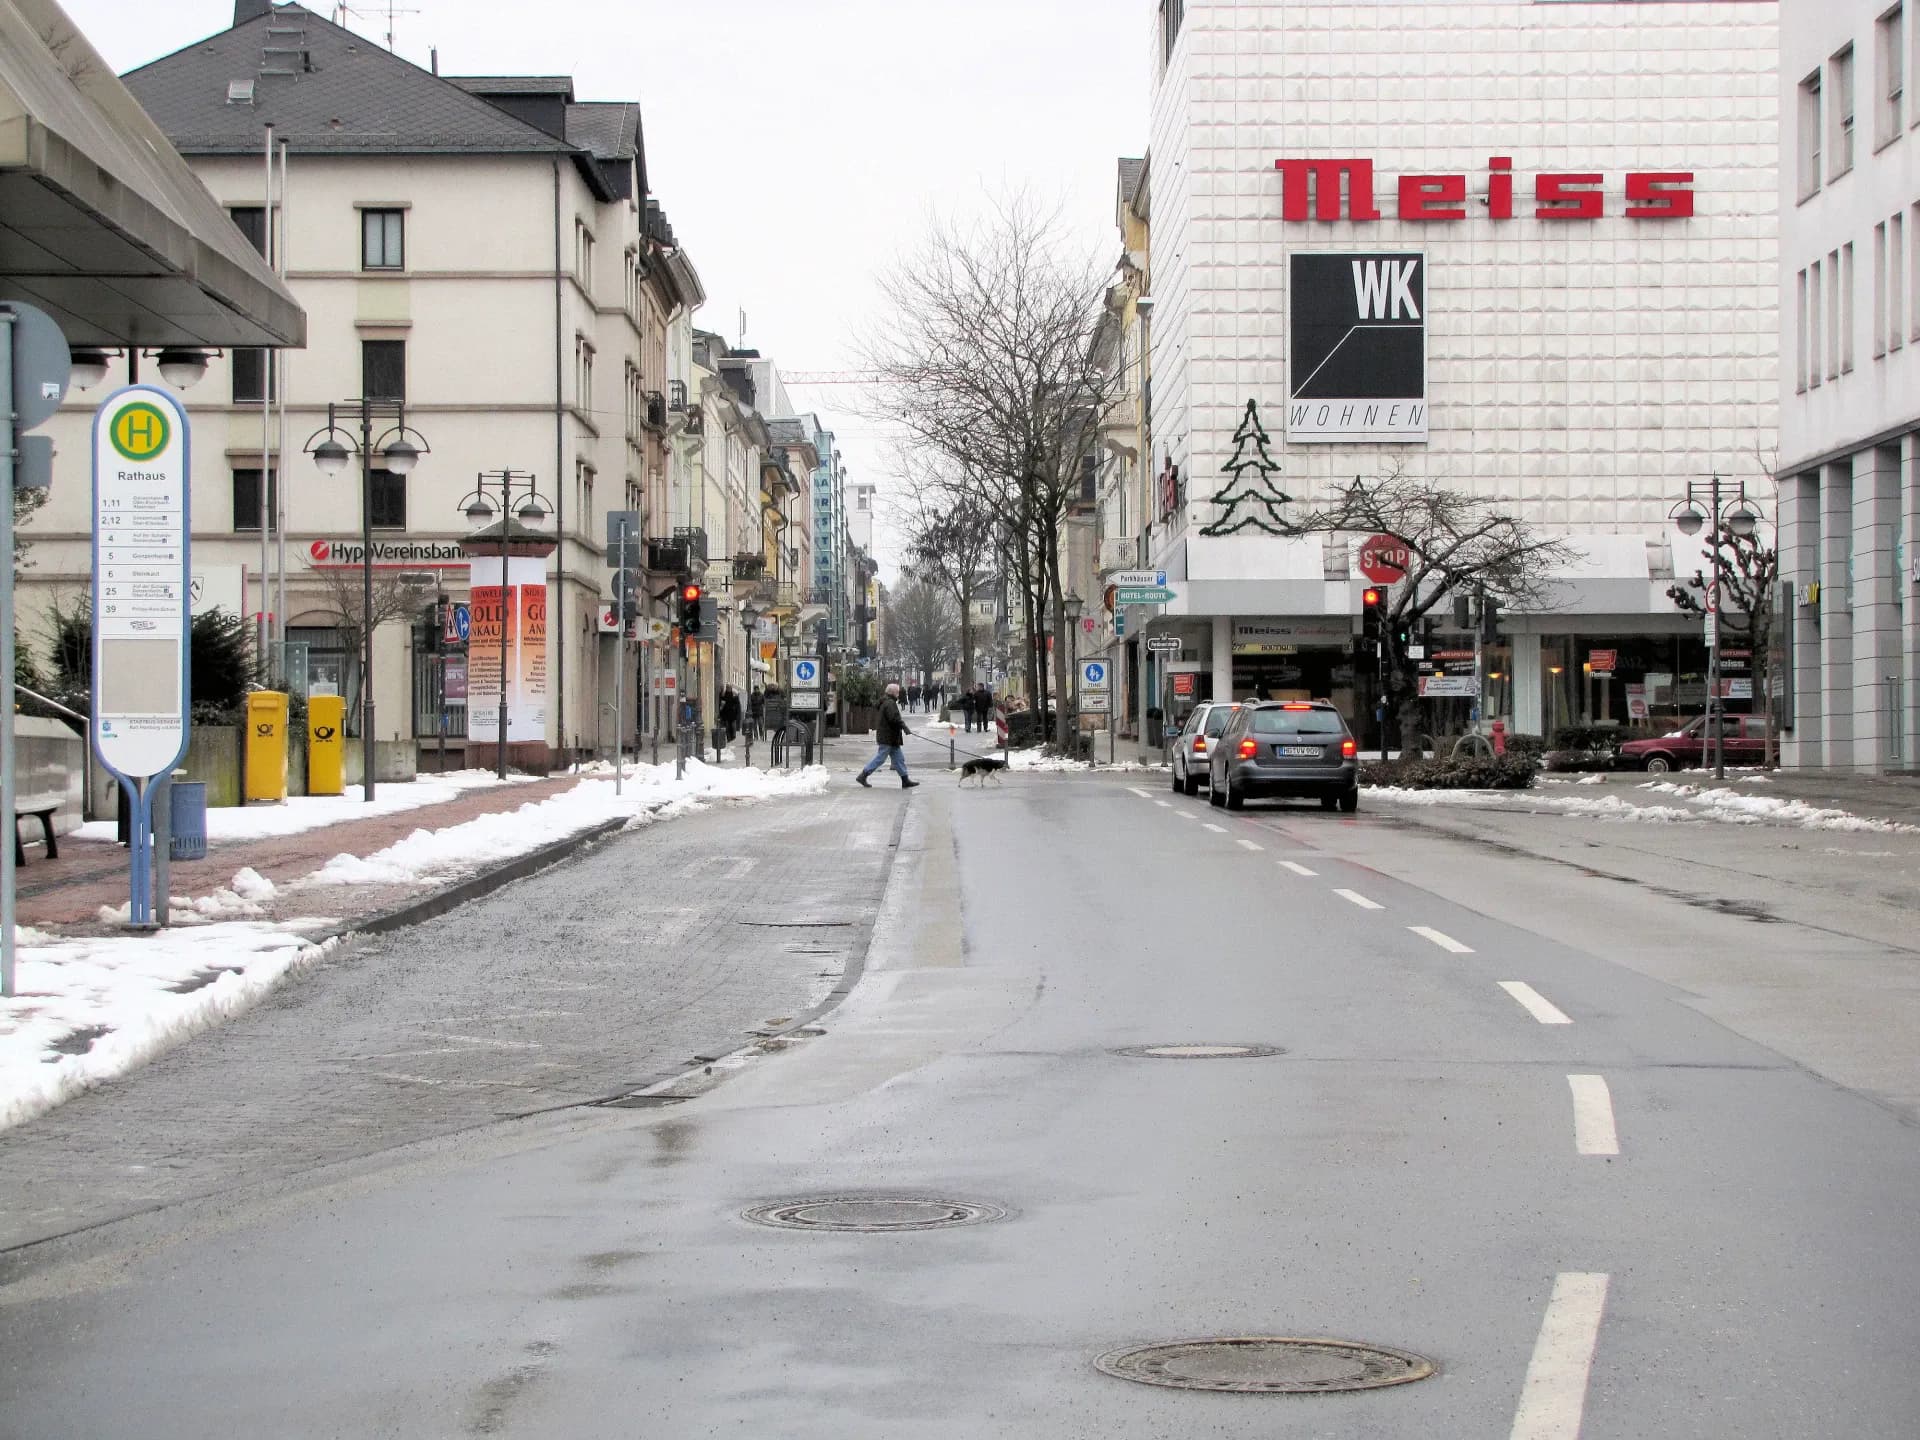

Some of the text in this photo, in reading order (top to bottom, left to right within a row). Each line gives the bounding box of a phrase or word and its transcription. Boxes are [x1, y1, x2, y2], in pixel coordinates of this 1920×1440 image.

[1275, 157, 1694, 221] Meiss
[1352, 260, 1421, 320] WK
[1290, 404, 1424, 427] WOHNEN
[128, 416, 152, 448] H
[118, 471, 167, 481] Rathaus
[108, 552, 114, 560] 5
[1364, 549, 1406, 569] STOP
[470, 605, 509, 622] OLD
[1239, 626, 1292, 635] Meiss
